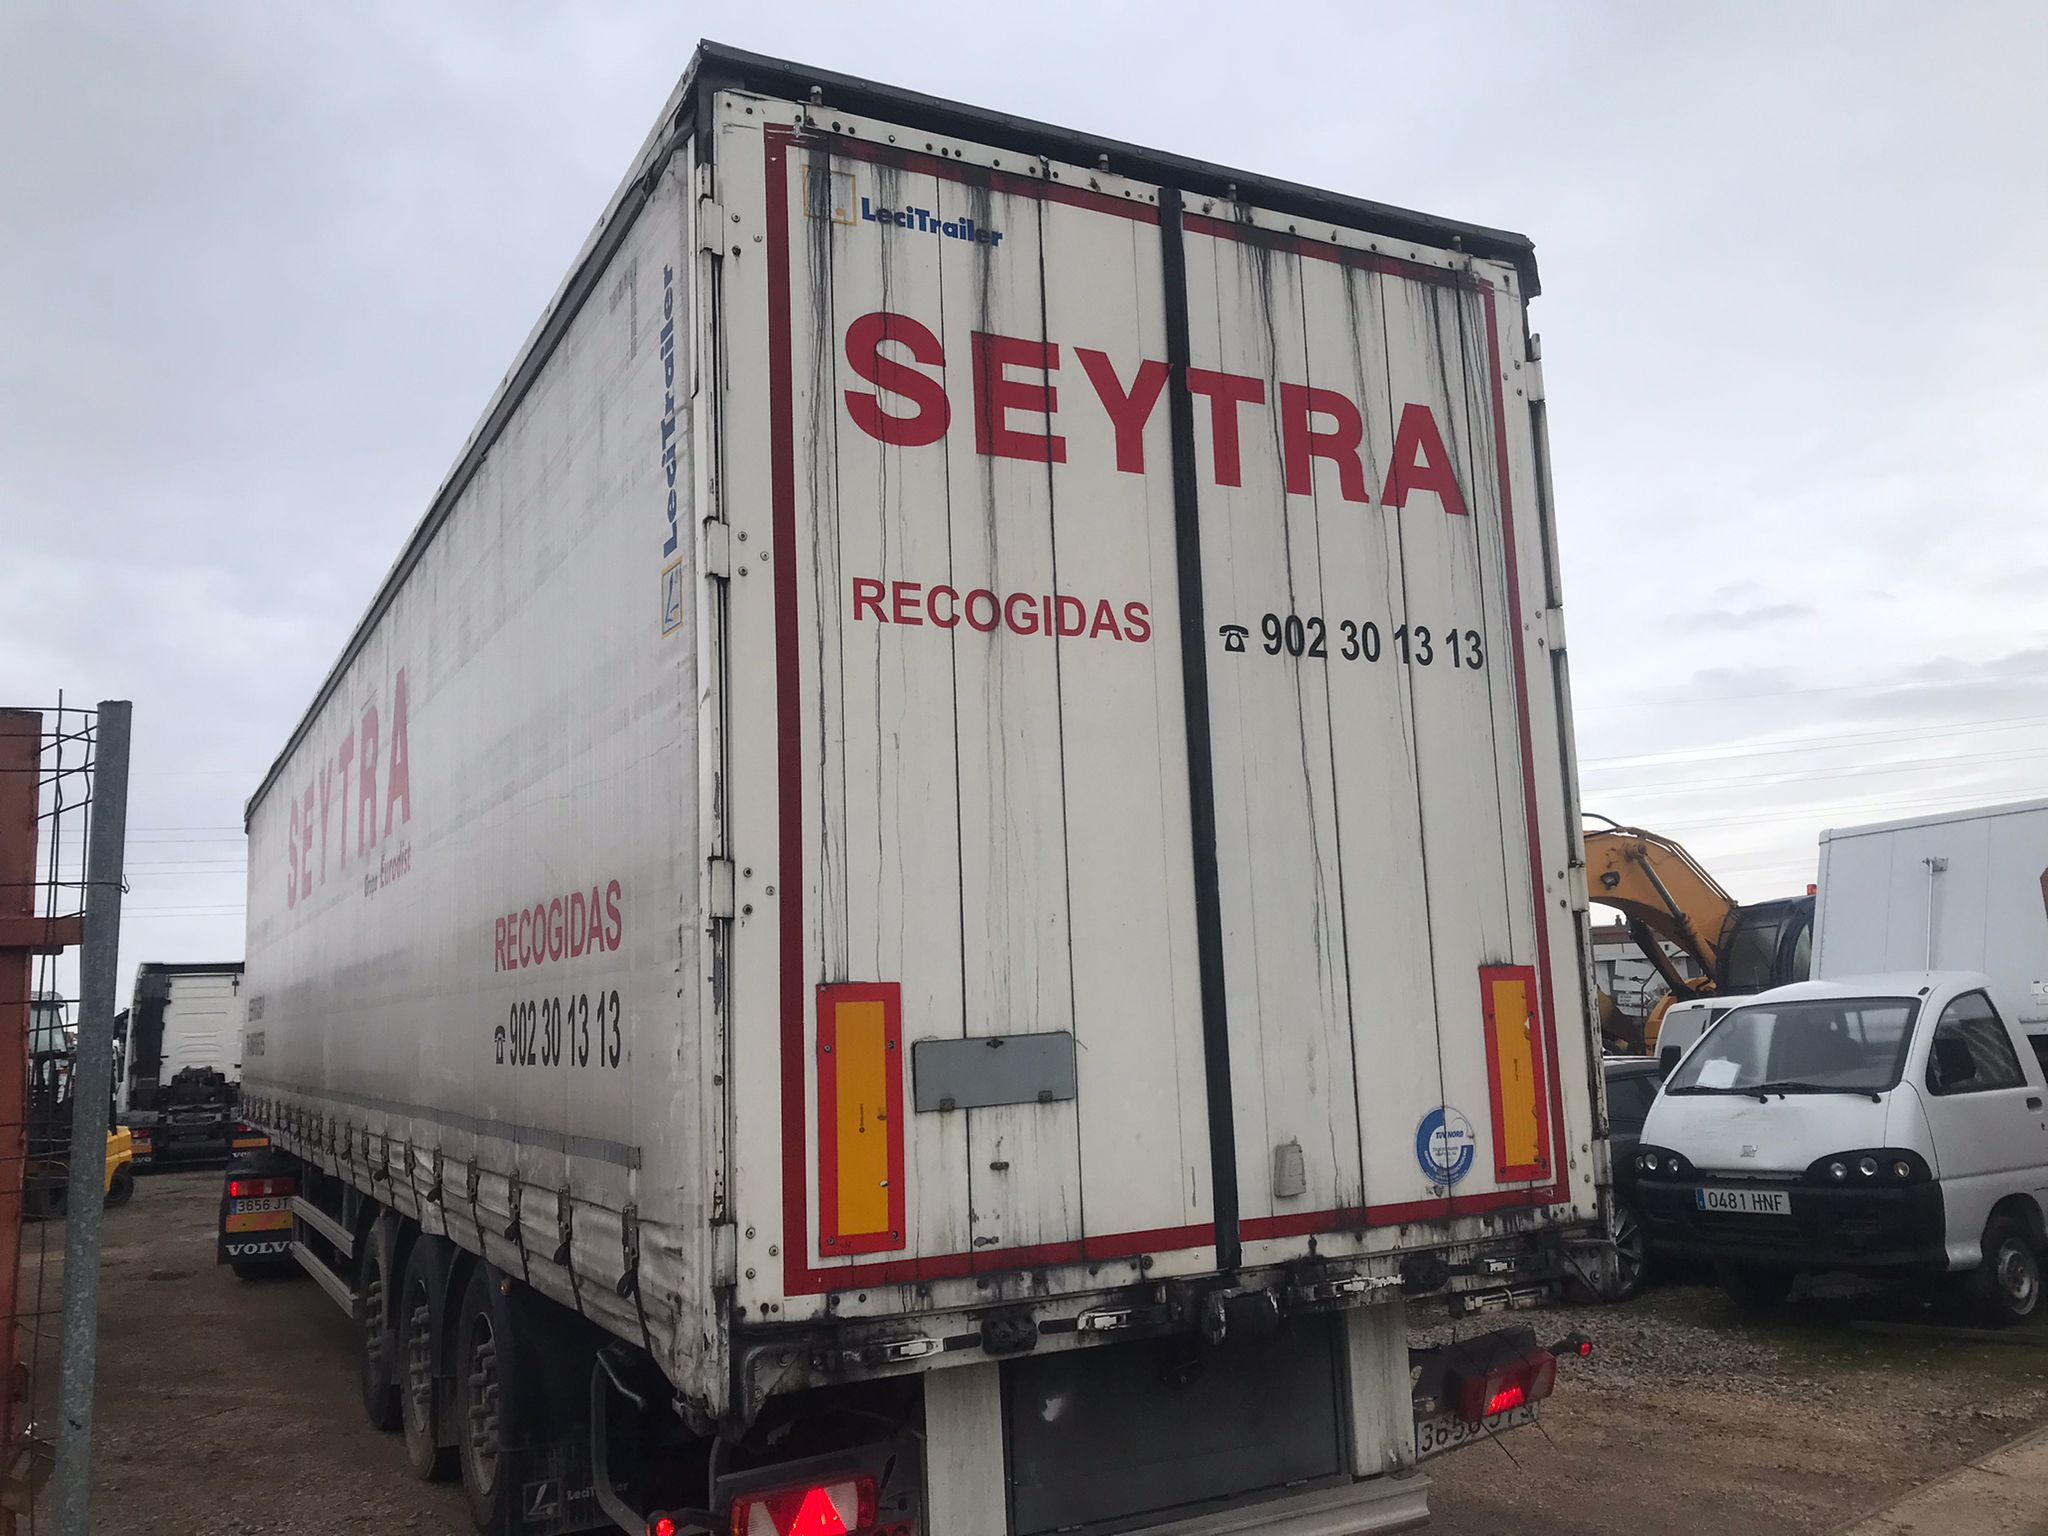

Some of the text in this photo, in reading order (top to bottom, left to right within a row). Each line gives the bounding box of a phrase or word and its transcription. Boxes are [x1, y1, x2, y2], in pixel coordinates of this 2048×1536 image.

[861, 197, 1003, 247] LeciTrailer
[660, 263, 679, 559] LeciTrailer
[844, 312, 1468, 516] SEYTRA
[852, 577, 1152, 643] RECOGIDAS
[1261, 613, 1484, 670] 902 30 13 13
[287, 666, 411, 911] SEYTRA
[495, 879, 622, 972] RECOGIDAS
[510, 990, 621, 1069] 902 30 13 13
[238, 1198, 290, 1213] 3656 JT
[1708, 1191, 1783, 1211] 0481 HNF
[225, 1241, 291, 1256] VOLV
